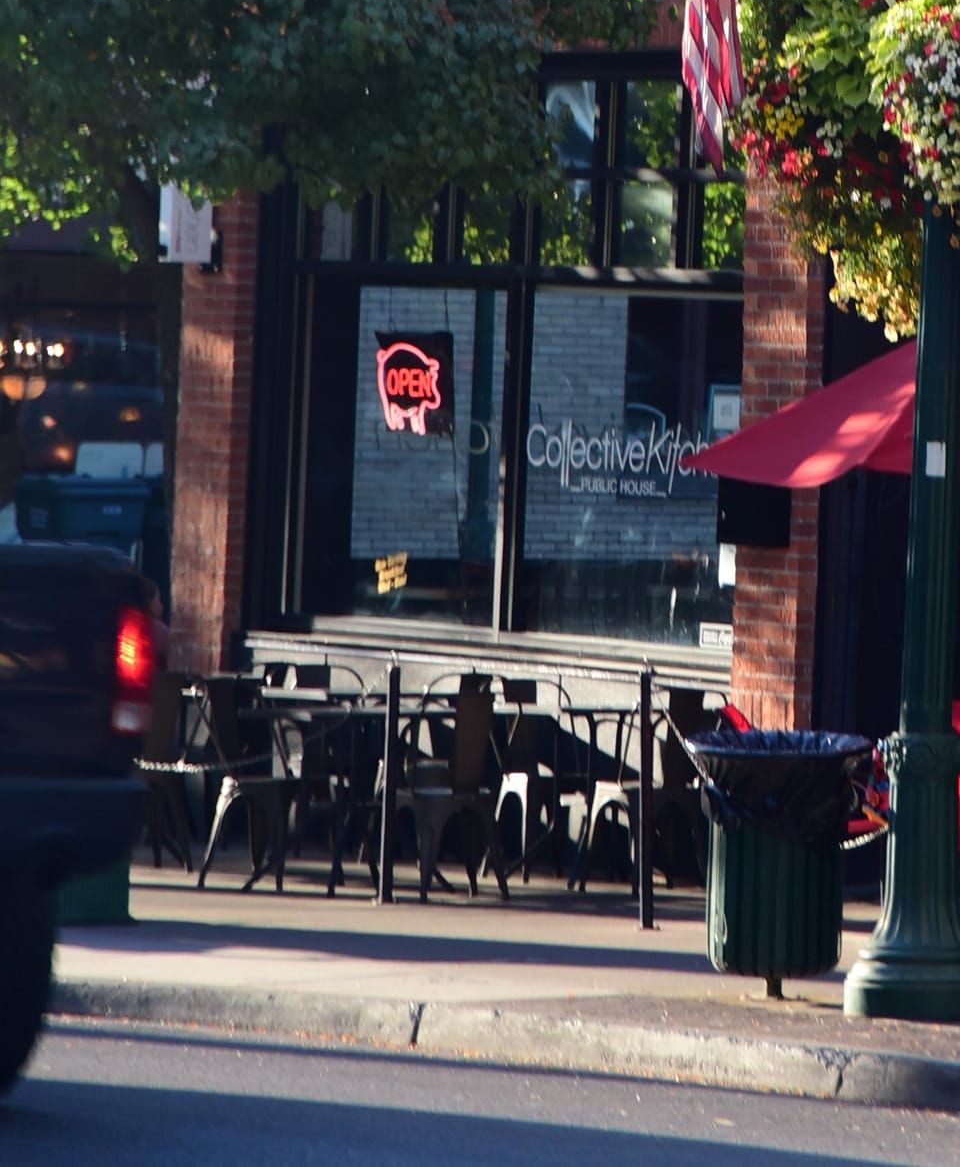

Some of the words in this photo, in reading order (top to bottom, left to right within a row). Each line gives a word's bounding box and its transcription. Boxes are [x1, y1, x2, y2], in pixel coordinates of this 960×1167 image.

[386, 367, 432, 397] OPEN
[581, 476, 617, 494] PUBLIC
[619, 477, 656, 496] HOUSE
